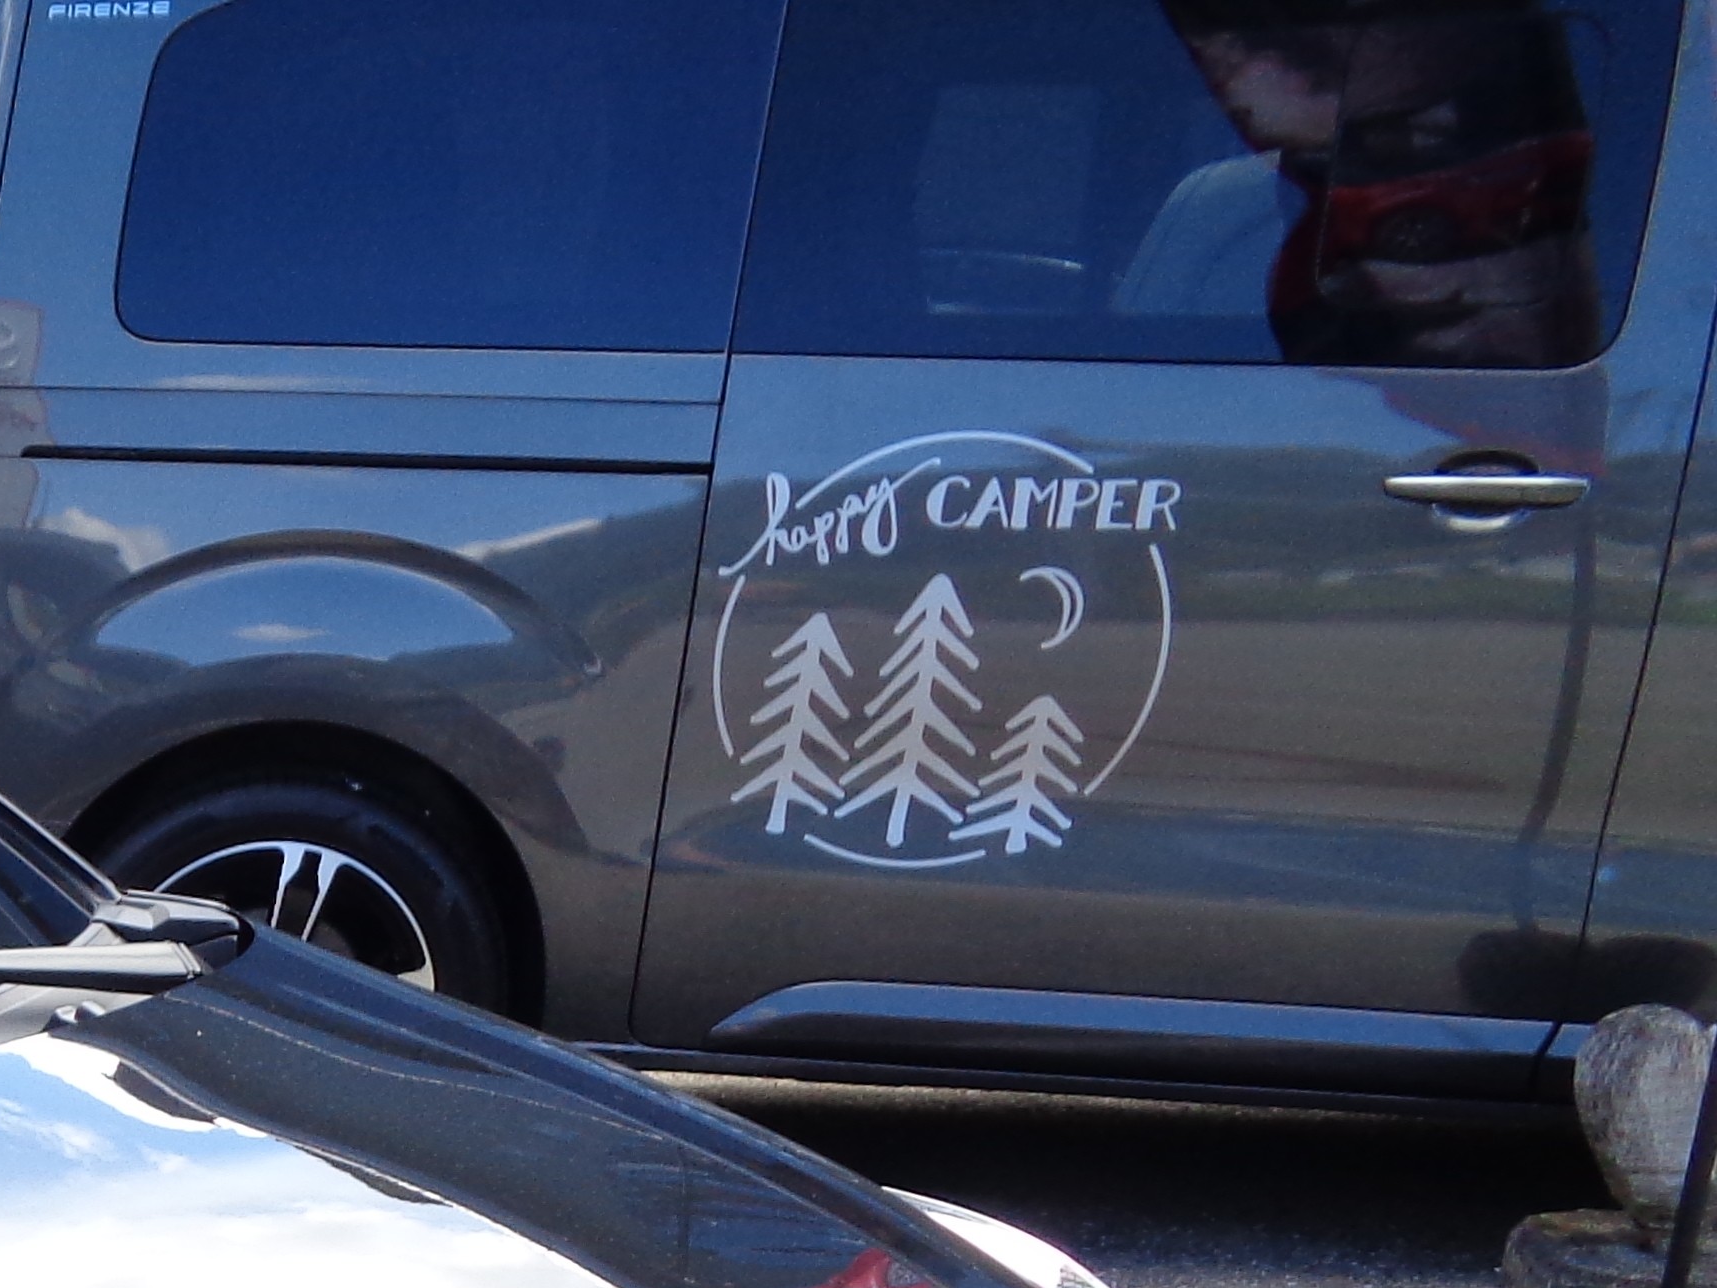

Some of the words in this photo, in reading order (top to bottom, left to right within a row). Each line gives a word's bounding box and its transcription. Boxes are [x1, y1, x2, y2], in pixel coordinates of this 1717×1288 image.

[48, 1, 171, 20] FIRENZE
[719, 457, 941, 576] happy
[925, 475, 1182, 532] CAMPER
